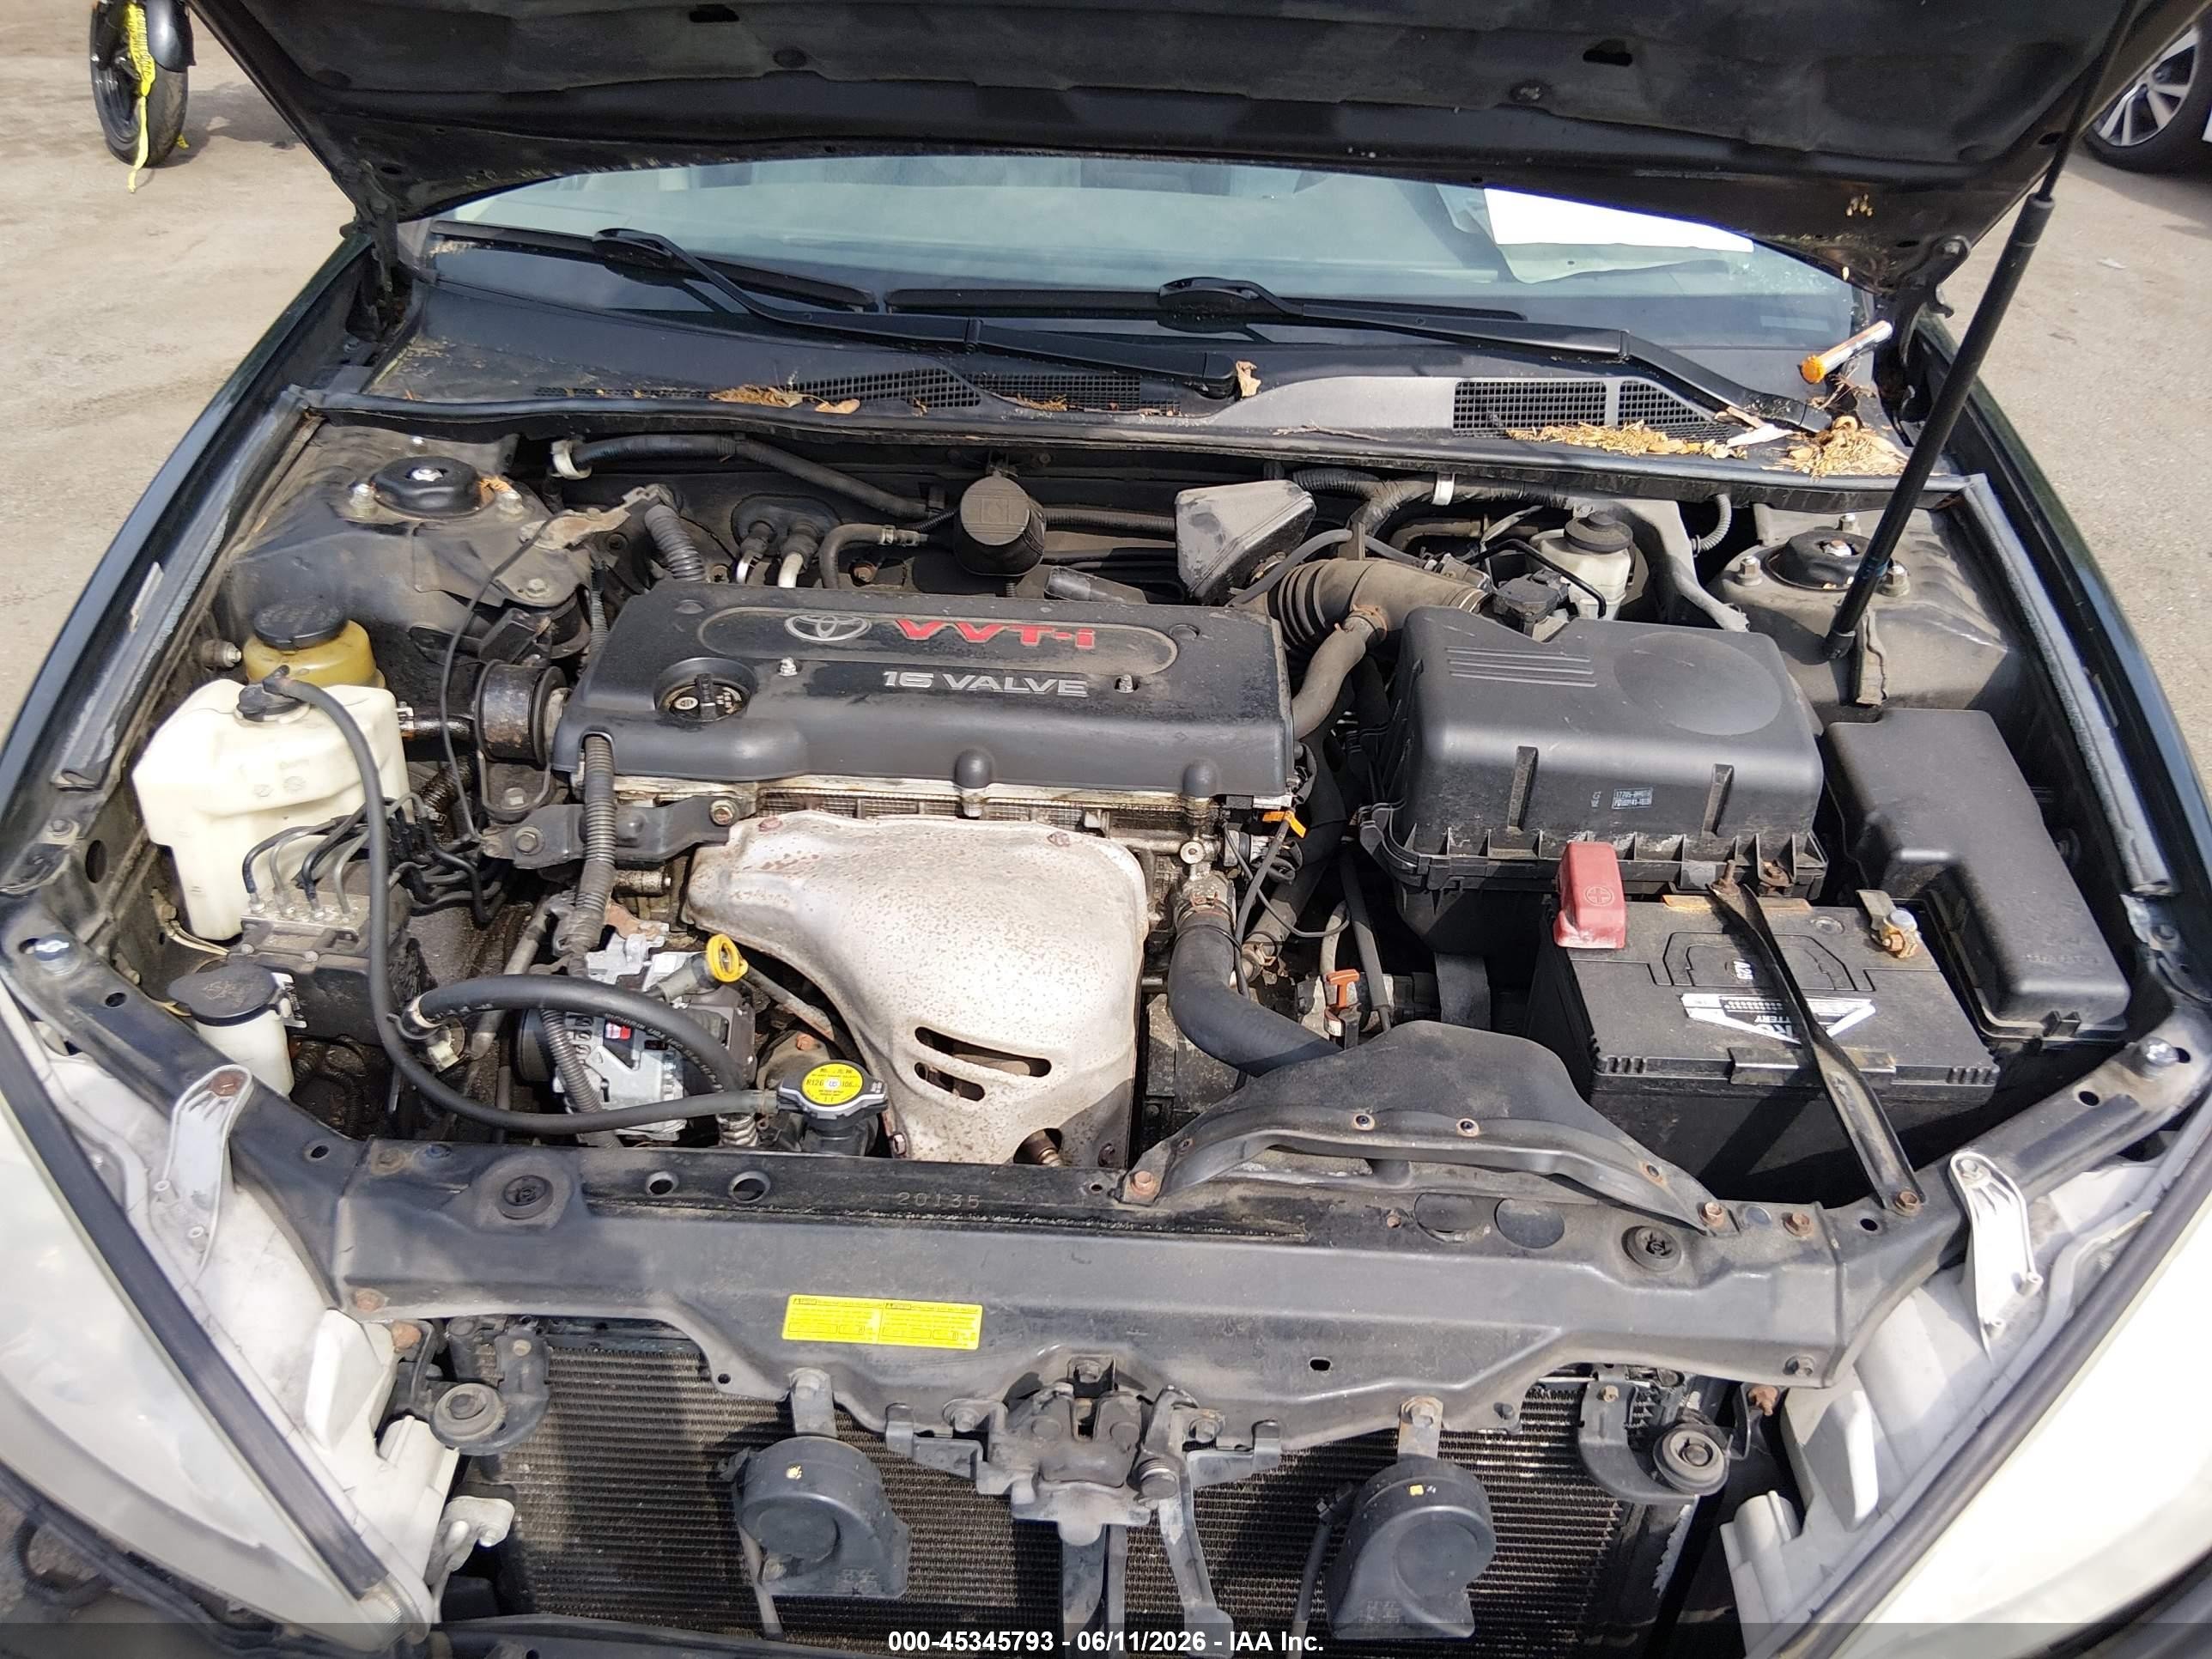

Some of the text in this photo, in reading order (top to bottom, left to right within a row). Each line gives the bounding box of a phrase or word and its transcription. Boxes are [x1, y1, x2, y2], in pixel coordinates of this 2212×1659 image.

[894, 618, 1095, 650] VVT-i
[883, 671, 1089, 698] 16 VALVE
[897, 1191, 981, 1210] 20135
